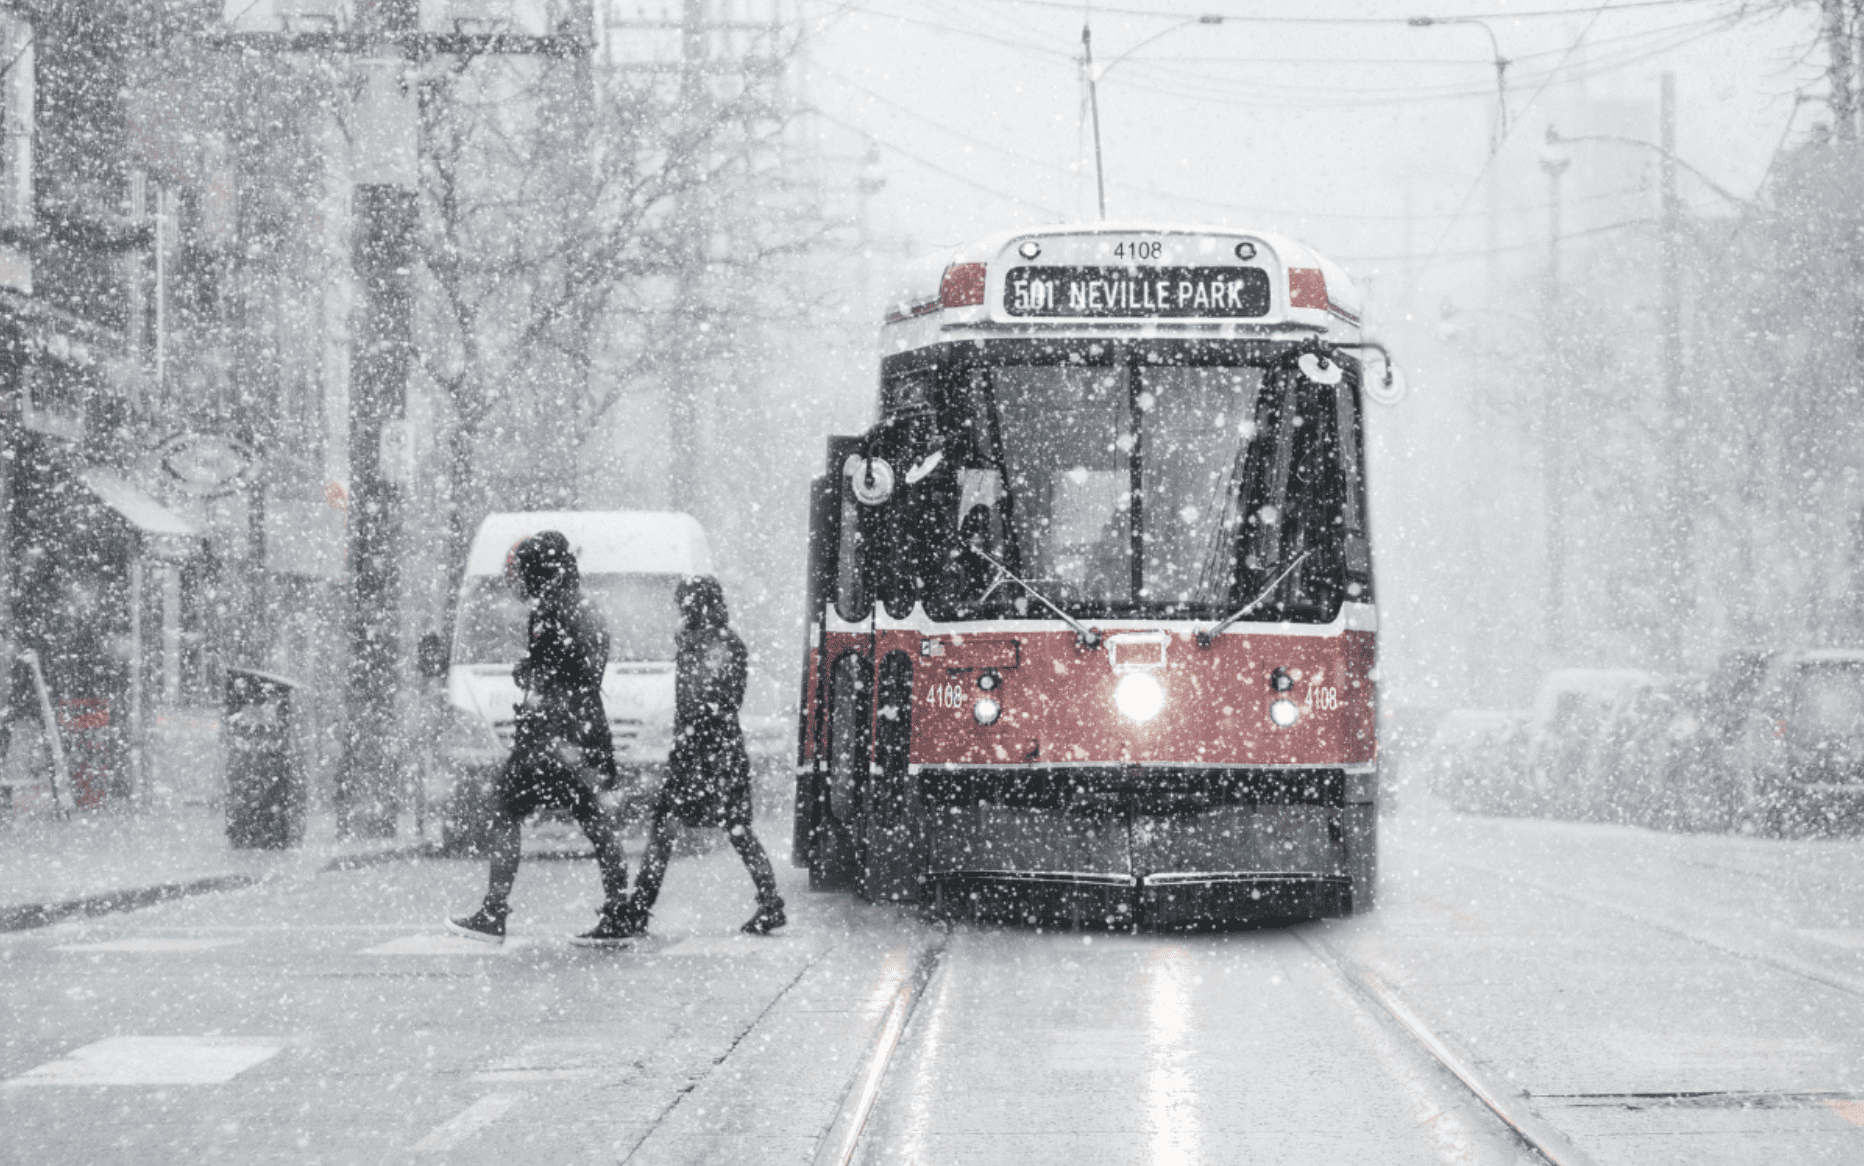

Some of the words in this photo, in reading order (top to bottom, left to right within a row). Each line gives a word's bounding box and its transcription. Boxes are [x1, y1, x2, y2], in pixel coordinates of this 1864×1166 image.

[1113, 242, 1162, 259] 4108
[1013, 281, 1054, 310] 501
[1069, 281, 1170, 309] NEVILLE
[1179, 281, 1243, 309] PARK
[926, 684, 962, 708] 4108
[1304, 686, 1338, 711] 4108
